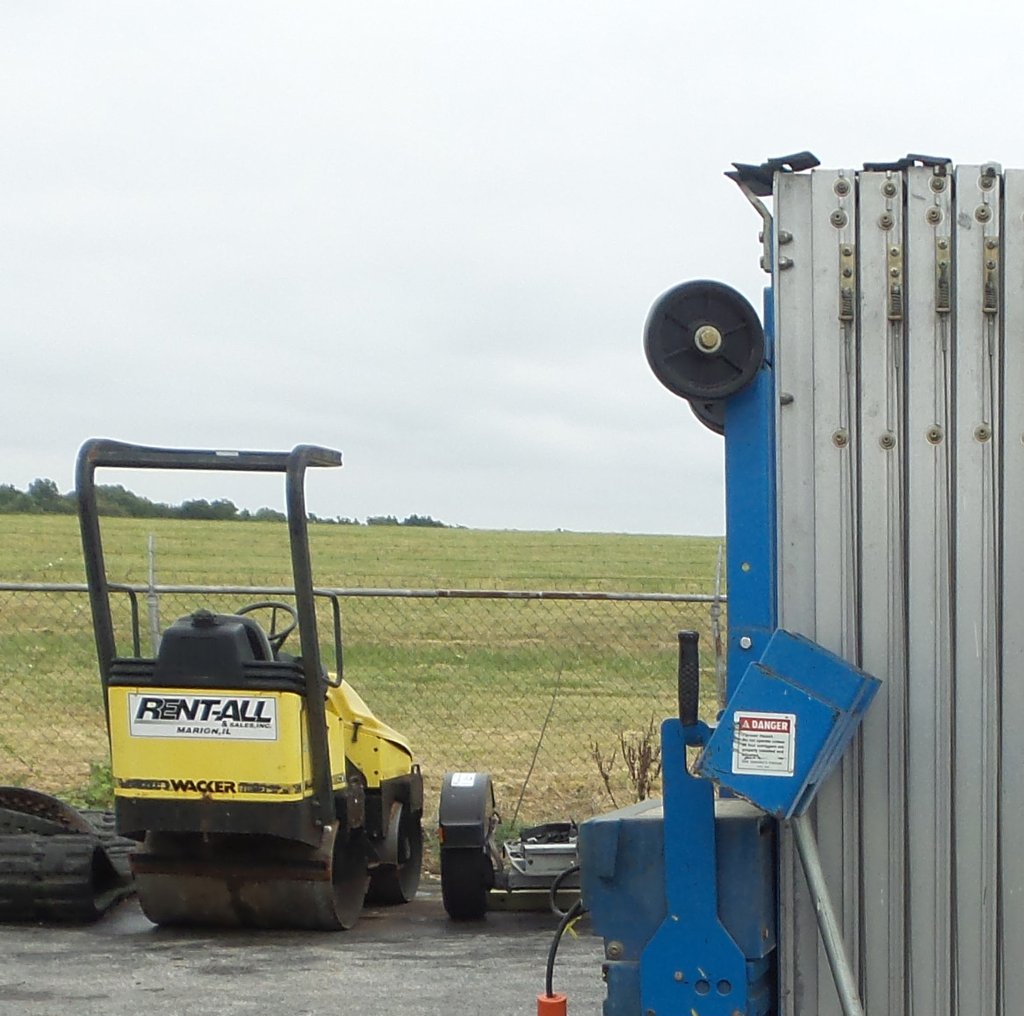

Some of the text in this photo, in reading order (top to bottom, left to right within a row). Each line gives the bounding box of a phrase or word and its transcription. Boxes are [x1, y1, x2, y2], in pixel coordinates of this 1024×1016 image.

[135, 697, 273, 723] RENT-ALL
[221, 719, 228, 728] &
[751, 719, 789, 731] DANGER
[176, 726, 232, 736] MARION,IL
[171, 779, 237, 793] WACKER
